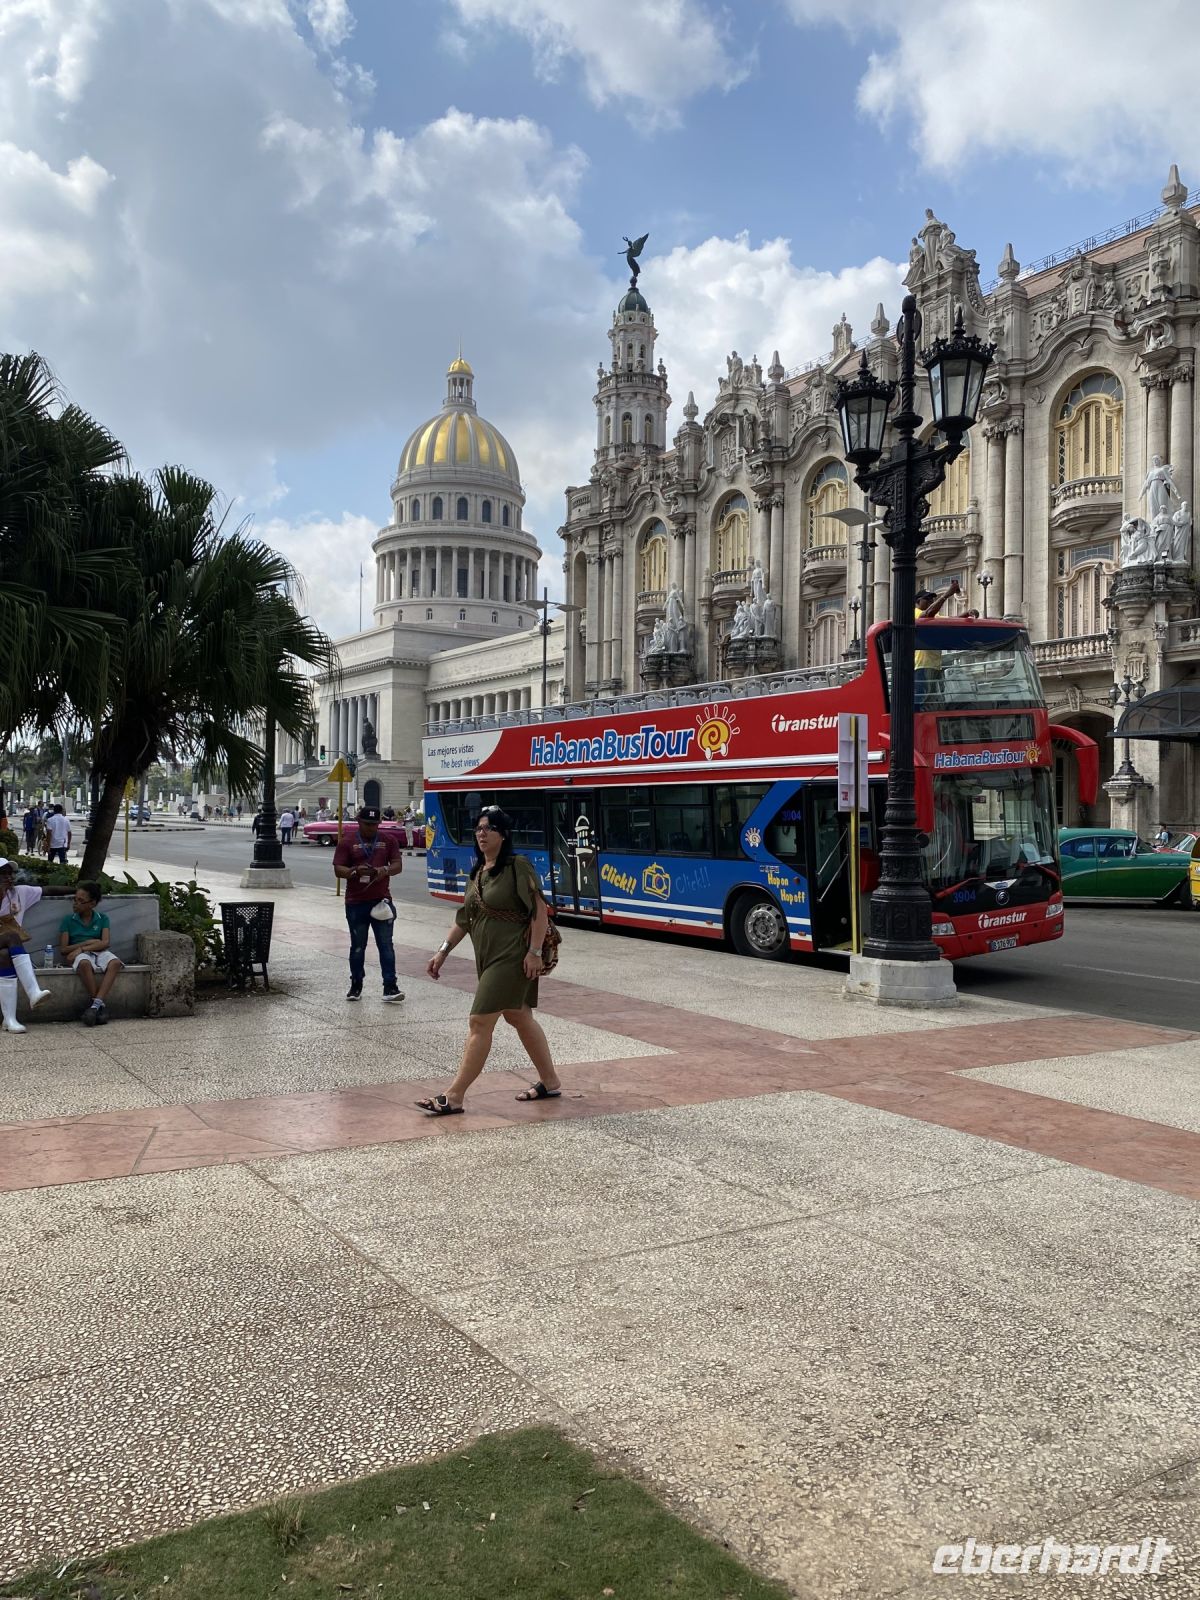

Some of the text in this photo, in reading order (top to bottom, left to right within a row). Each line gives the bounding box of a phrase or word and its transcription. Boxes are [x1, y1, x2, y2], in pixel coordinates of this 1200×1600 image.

[428, 744, 474, 757] Las mejores vistas
[530, 725, 694, 766] HabanaBusTour
[441, 757, 480, 769] The best views
[934, 749, 1026, 768] HabanaBusTour
[601, 864, 637, 895] Click!!
[767, 872, 789, 888] Hop on
[780, 889, 805, 905] Hop off
[953, 889, 977, 904] 3904
